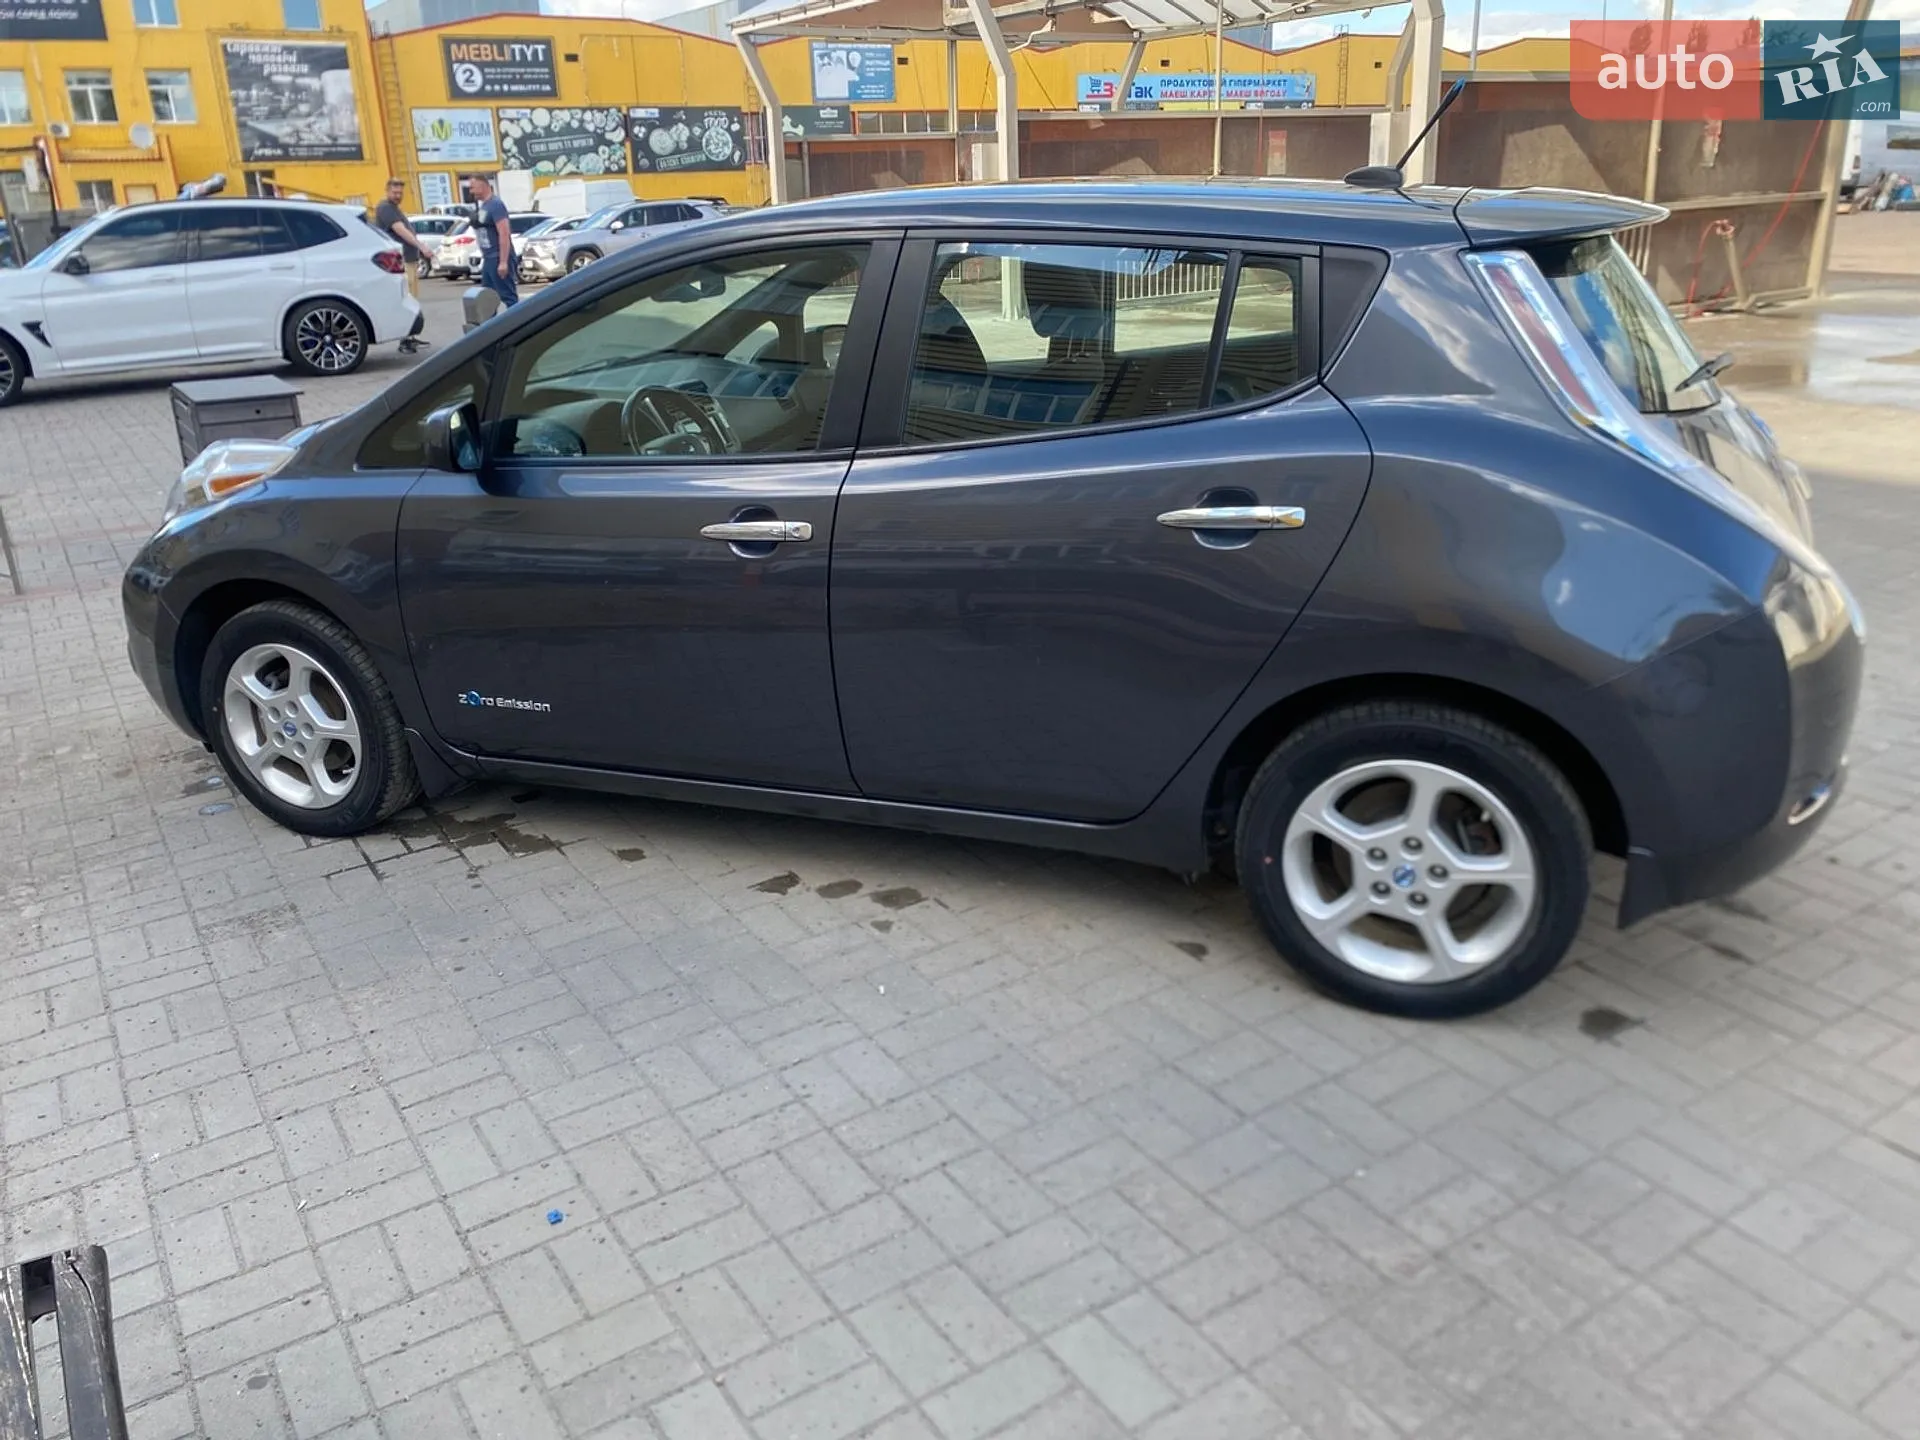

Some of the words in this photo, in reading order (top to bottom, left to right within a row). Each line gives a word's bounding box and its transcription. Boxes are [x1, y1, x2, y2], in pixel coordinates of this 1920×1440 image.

[450, 43, 546, 62] MEBLITYT
[462, 68, 476, 83] 2
[496, 697, 551, 712] Emission
